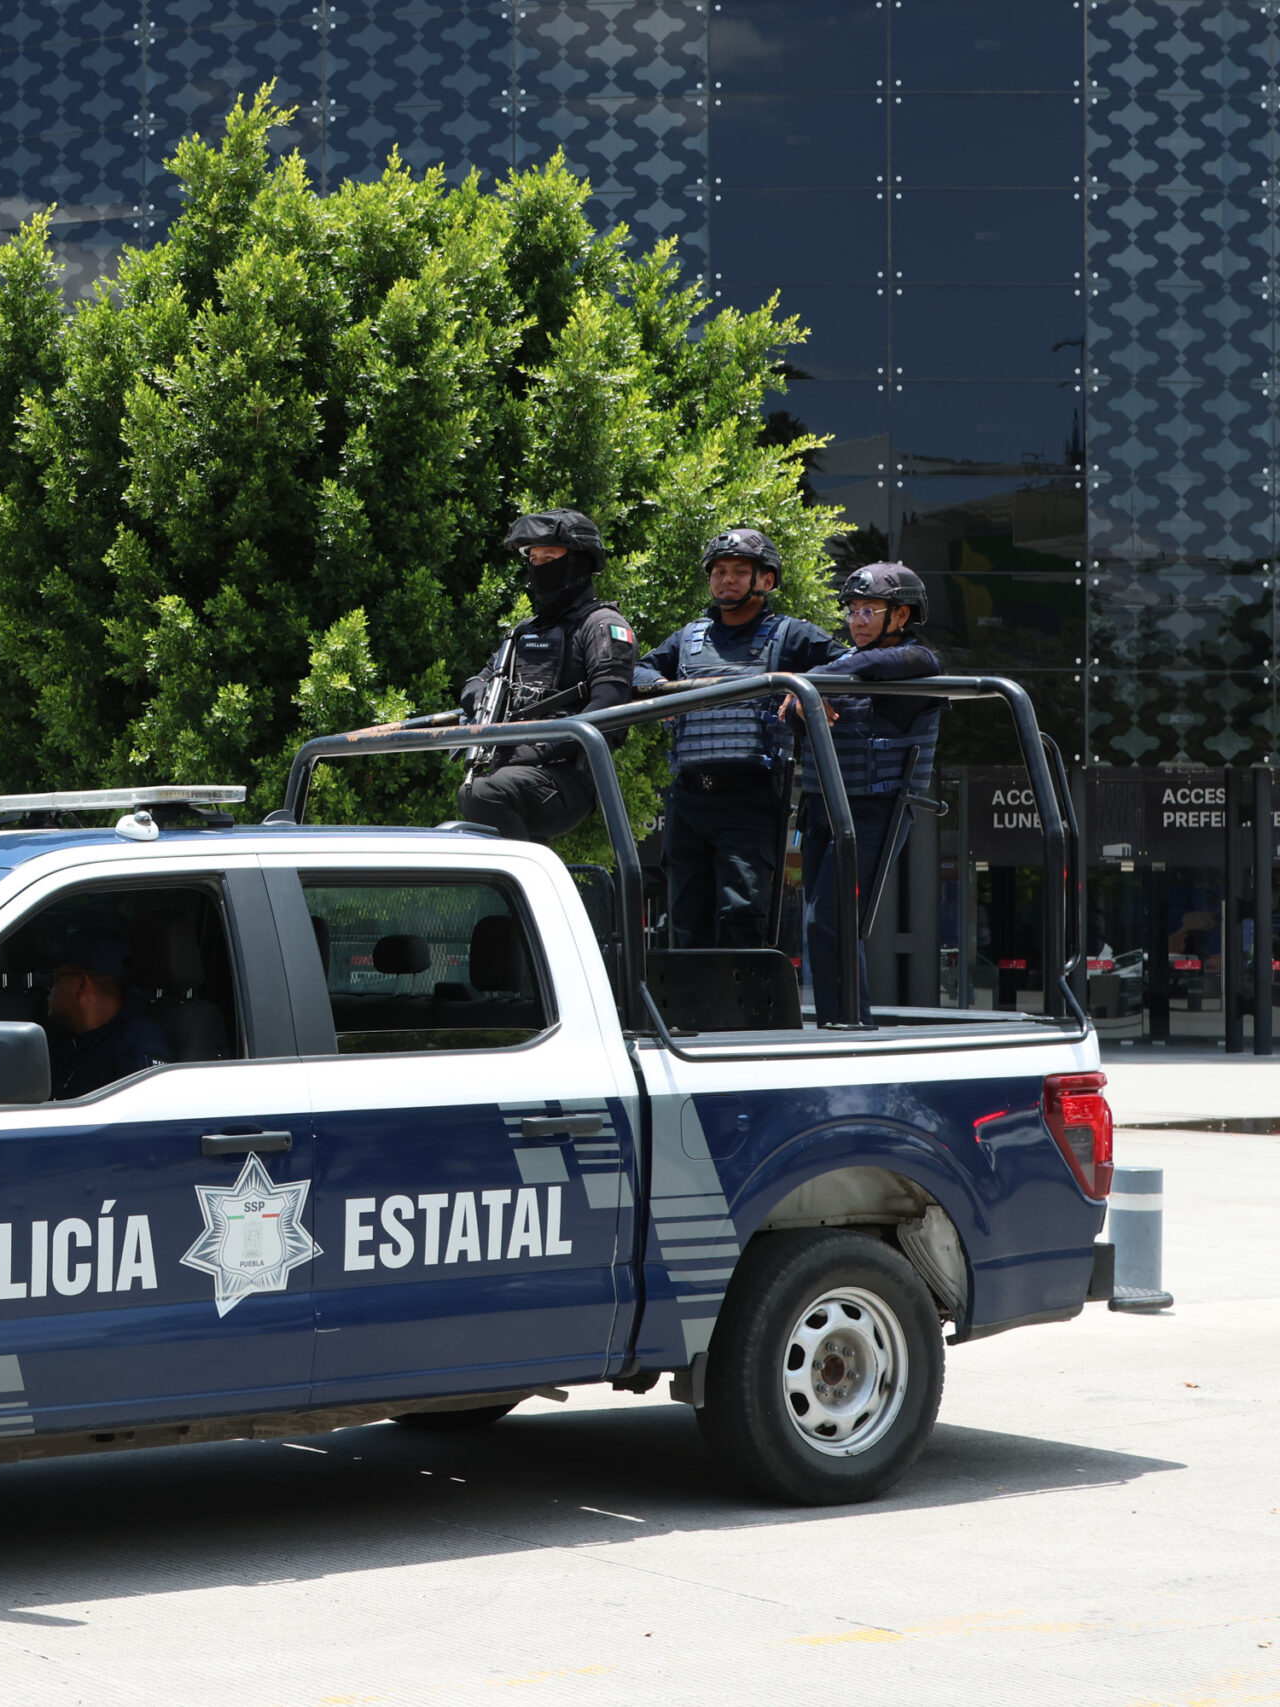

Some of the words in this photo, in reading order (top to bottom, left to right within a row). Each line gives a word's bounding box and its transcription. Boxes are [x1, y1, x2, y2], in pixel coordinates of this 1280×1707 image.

[992, 789, 1034, 805] ACC
[1162, 788, 1225, 804] ACCES
[244, 1201, 265, 1212] SSP
[344, 1186, 573, 1272] ESTATAL
[240, 1260, 265, 1268] PUEBLA
